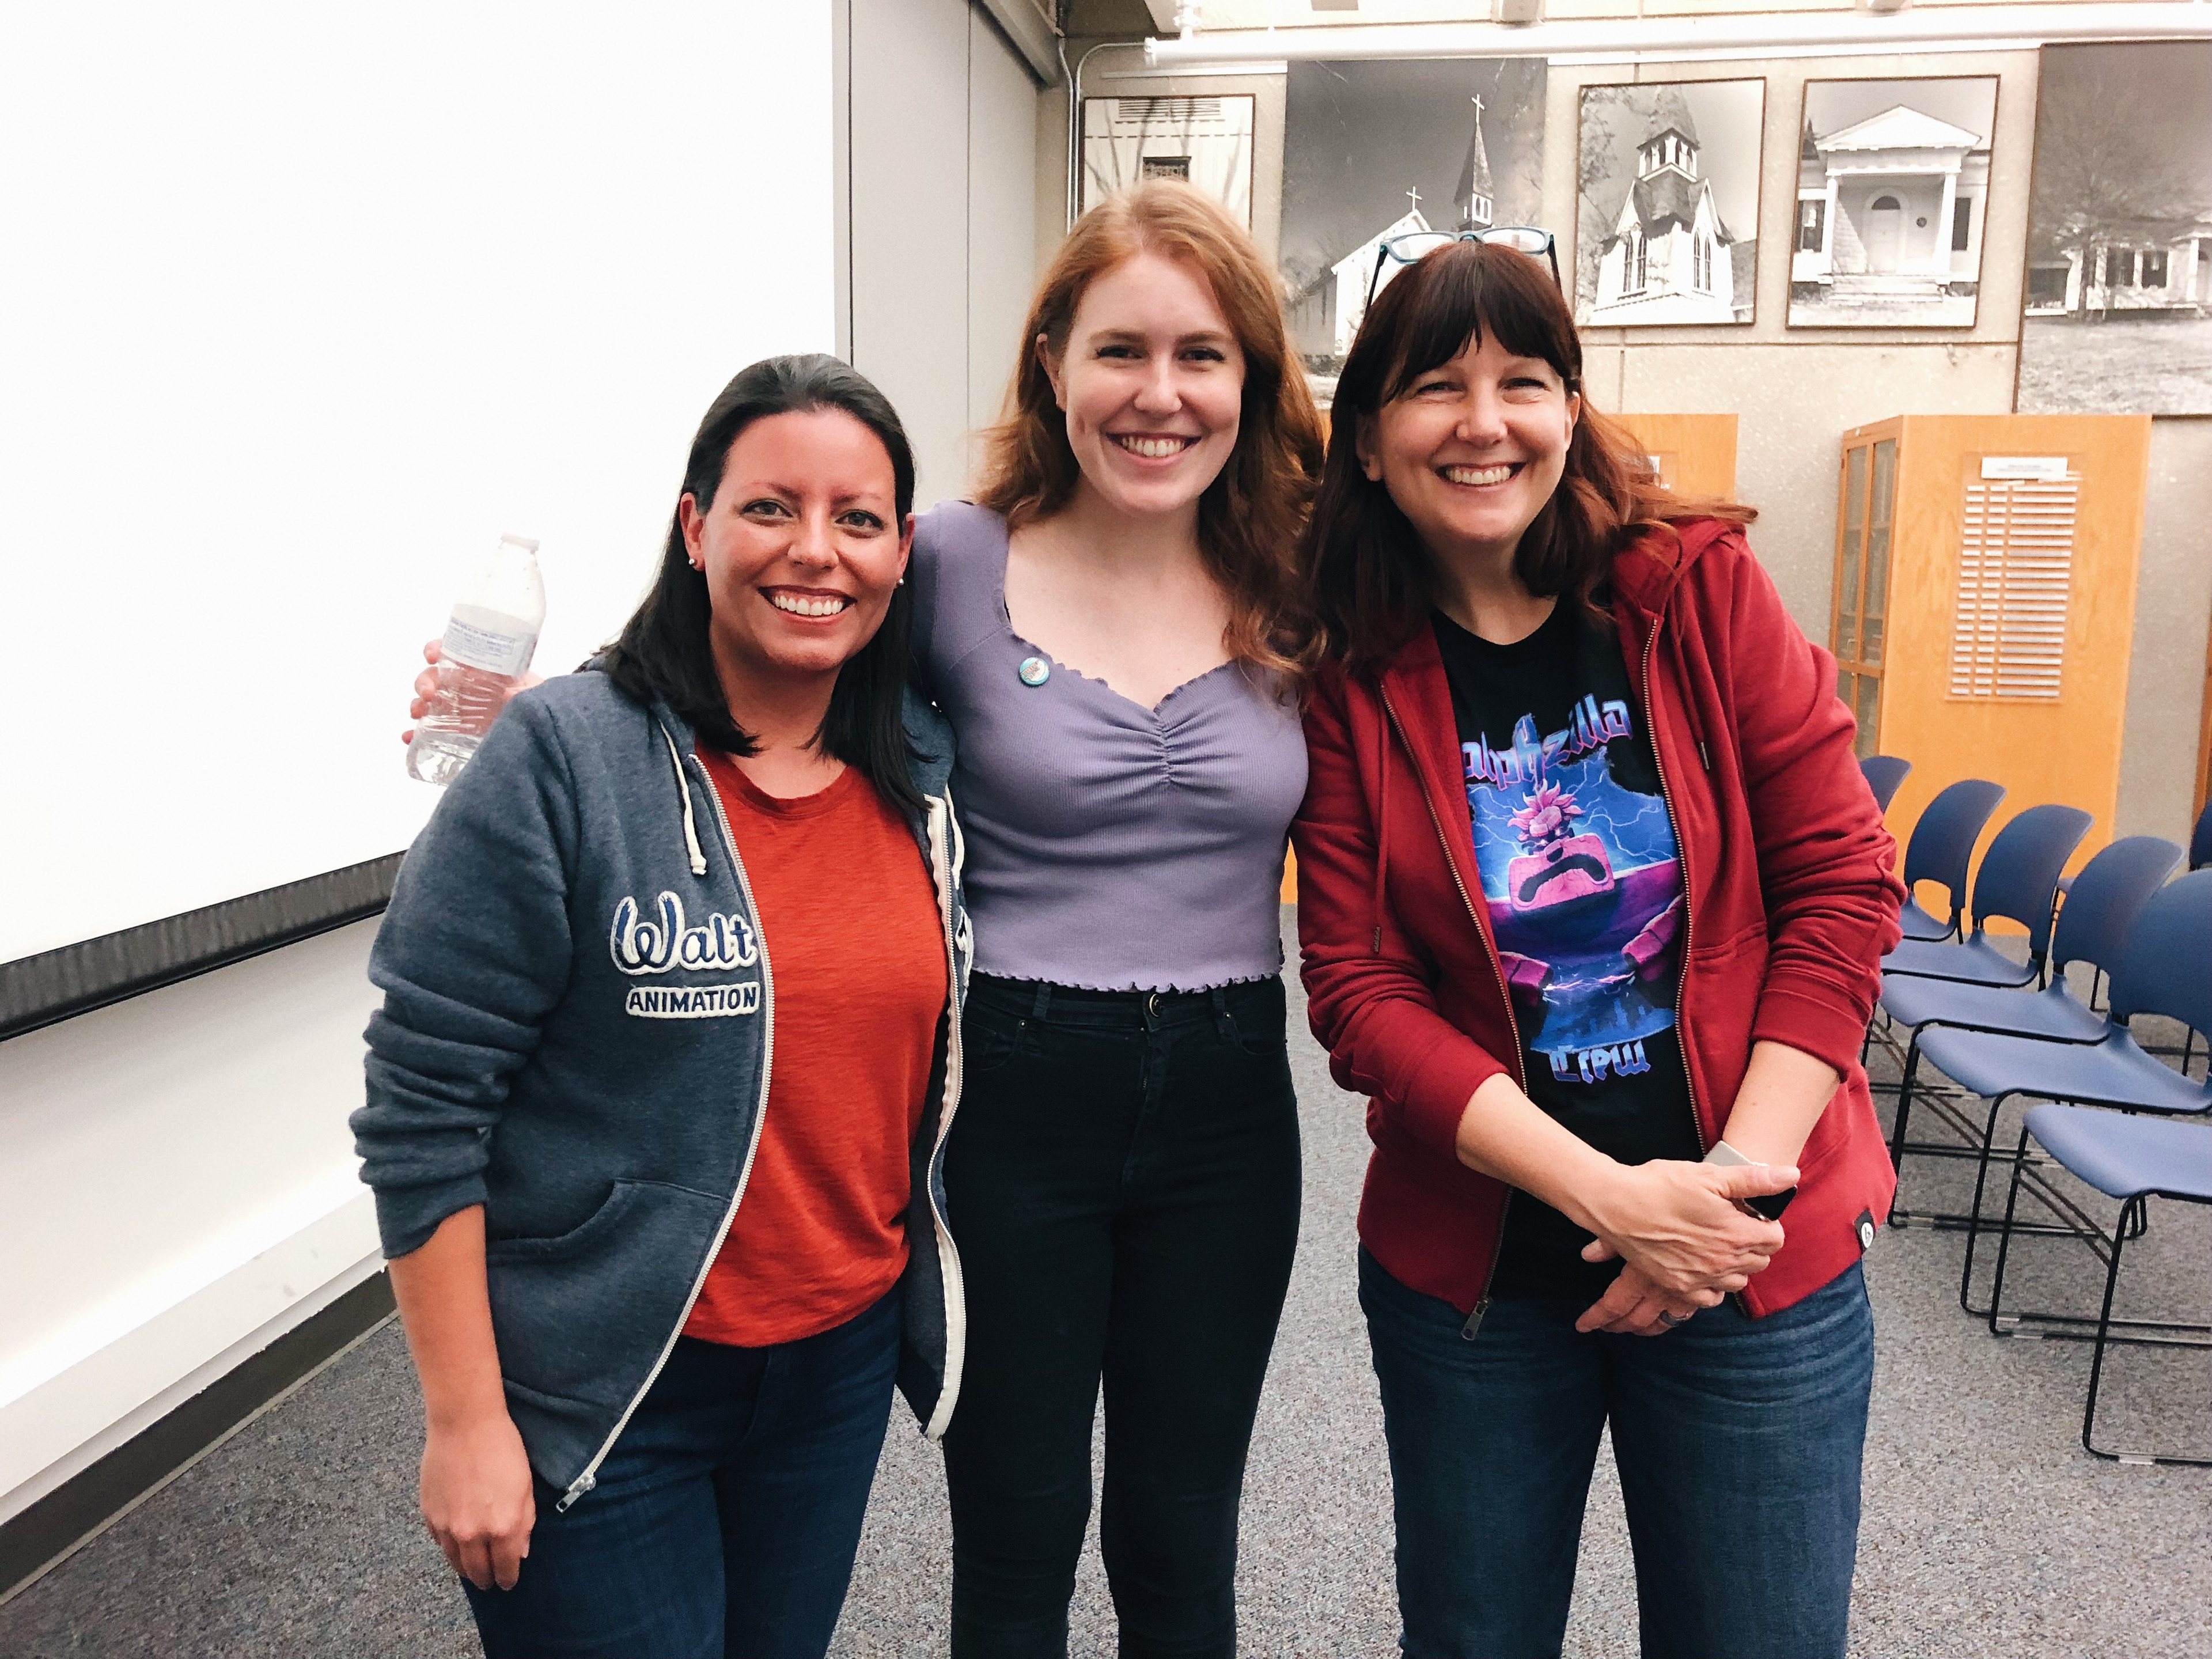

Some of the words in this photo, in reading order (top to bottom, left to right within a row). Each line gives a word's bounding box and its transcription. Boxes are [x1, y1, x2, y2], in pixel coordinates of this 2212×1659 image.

[611, 892, 757, 974] Walt
[628, 986, 757, 1013] ANIMATION
[1549, 1040, 1651, 1084] Crew
